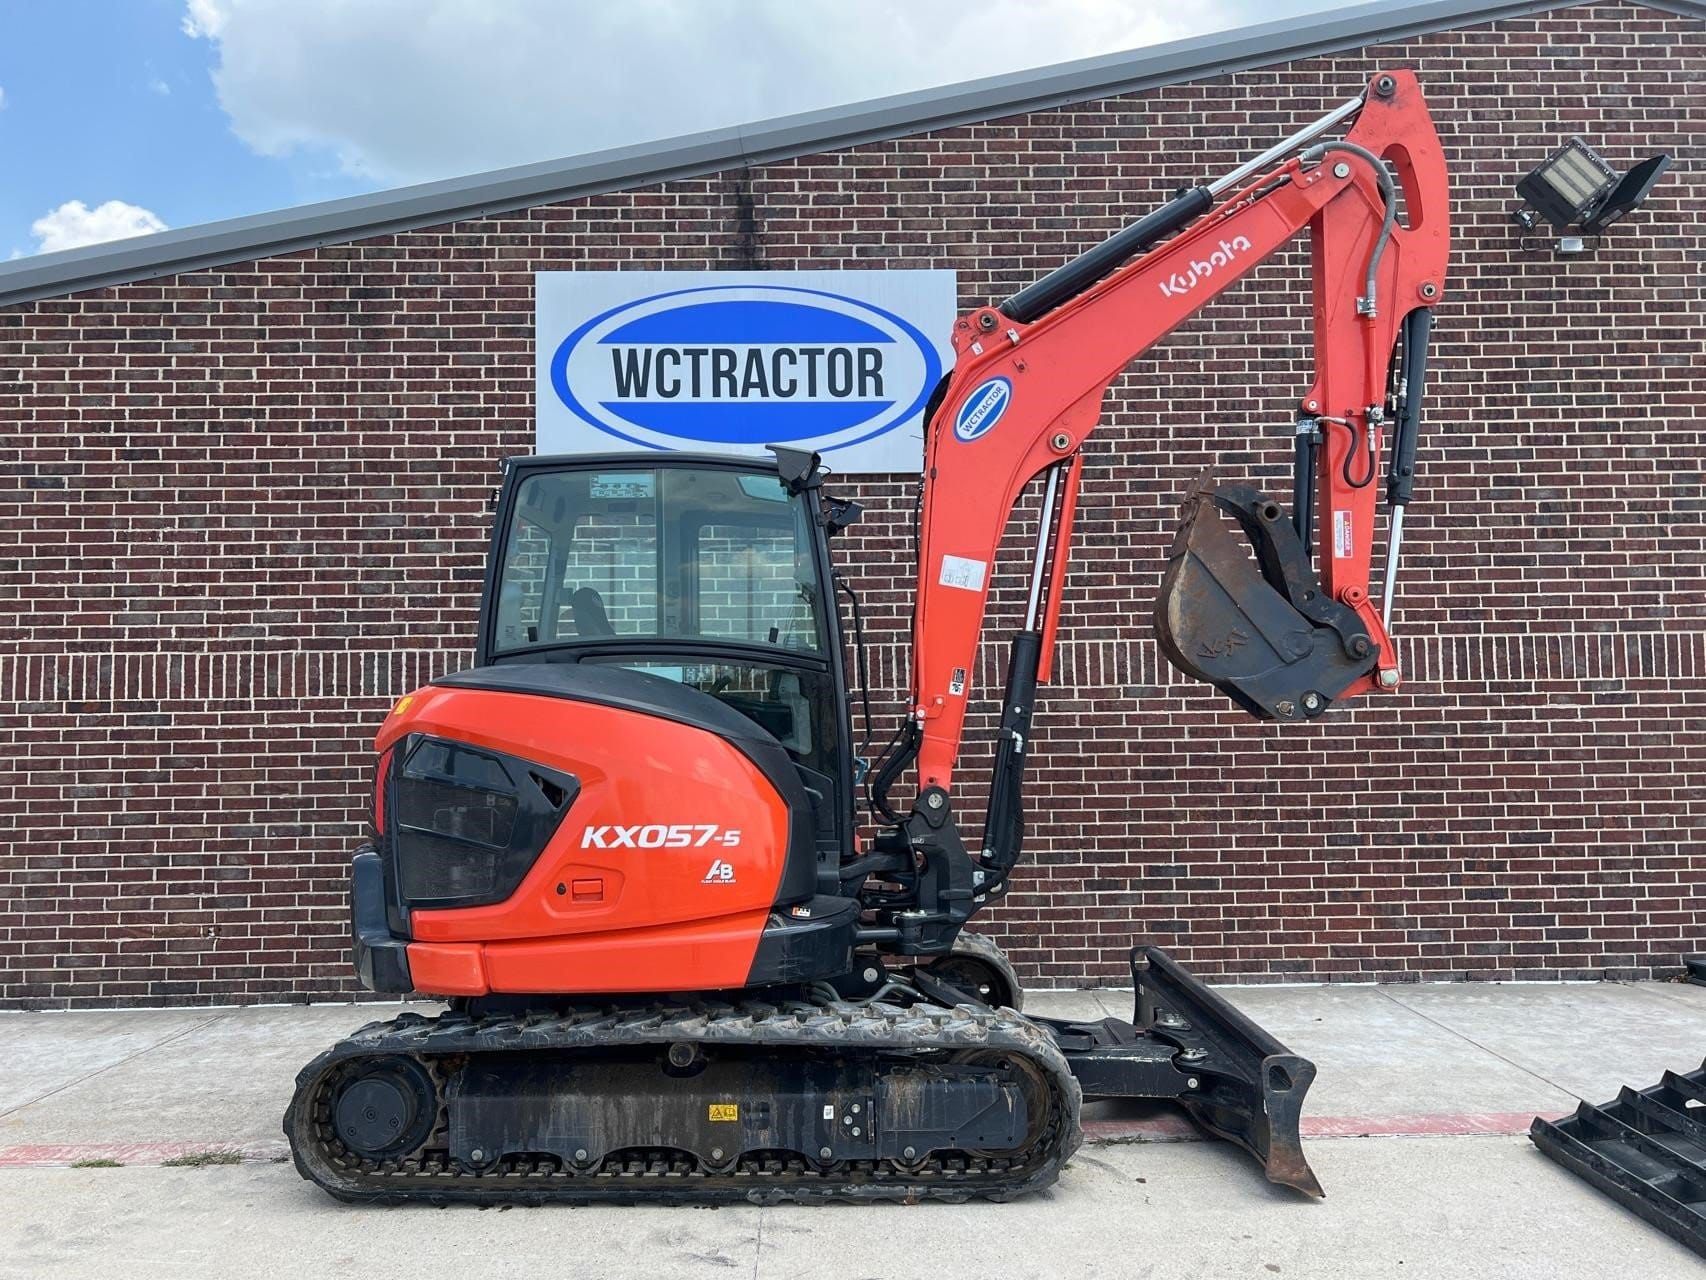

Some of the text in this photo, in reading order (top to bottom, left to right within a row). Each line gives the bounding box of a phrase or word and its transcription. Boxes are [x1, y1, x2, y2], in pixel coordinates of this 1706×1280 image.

[1158, 235, 1252, 297] Kubota
[611, 347, 884, 398] WCTRACTOR
[963, 386, 1004, 432] WCTRACTOR
[580, 824, 741, 848] KX057-5
